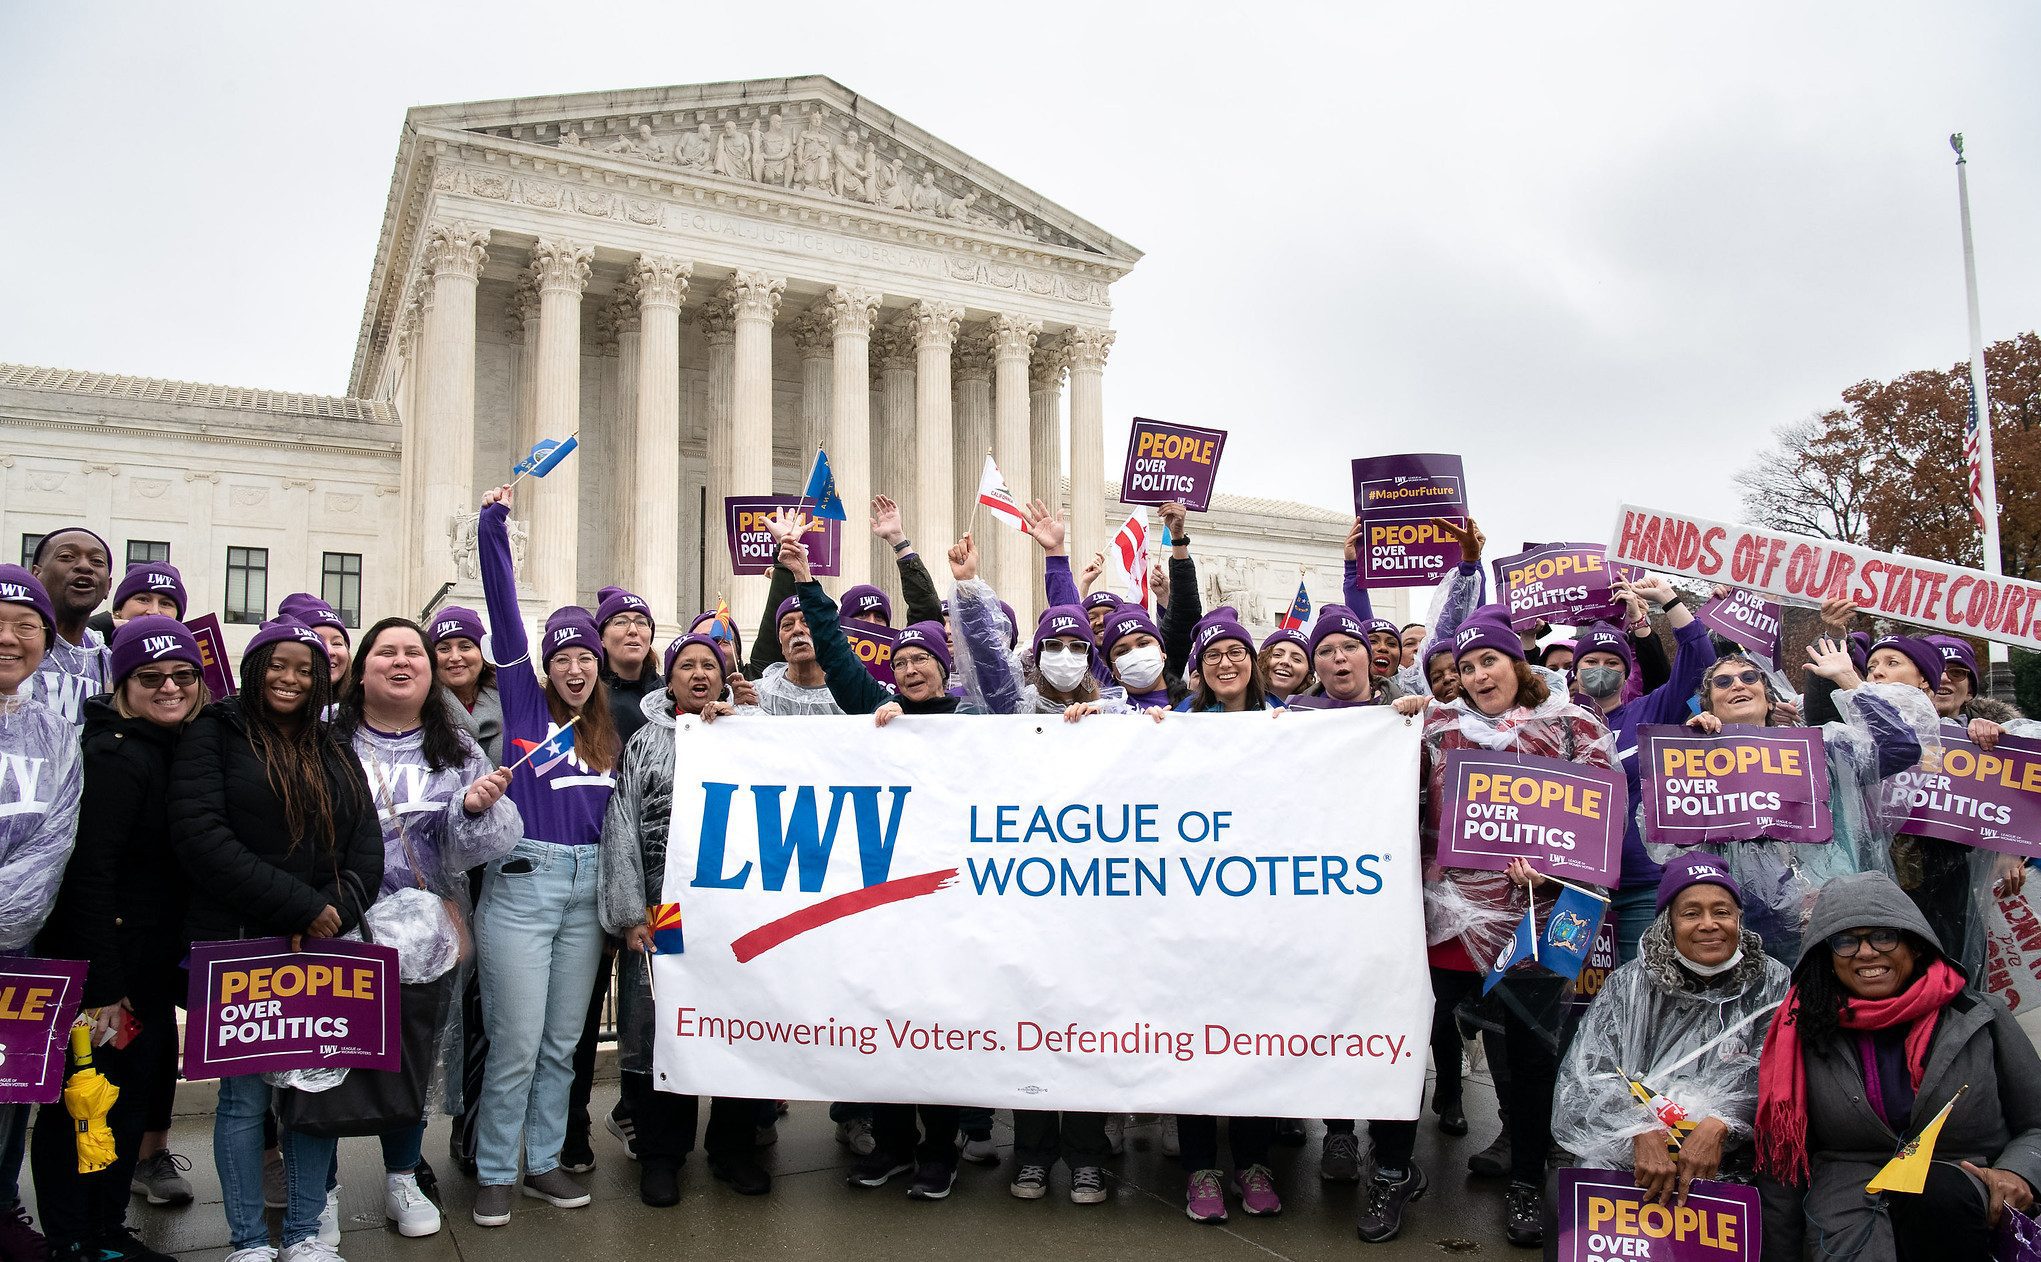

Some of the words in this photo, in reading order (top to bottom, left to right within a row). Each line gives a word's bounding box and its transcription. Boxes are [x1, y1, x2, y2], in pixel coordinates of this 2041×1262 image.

[681, 212, 746, 238] EQUAL
[751, 223, 824, 250] JUSTICE
[832, 238, 890, 264] UNDER
[898, 254, 932, 271] LAW
[1137, 432, 1214, 465] PEOPLE
[1135, 458, 1167, 473] OVER
[1131, 473, 1195, 493] POLITICS
[1368, 486, 1454, 500] #MapOurFuture
[740, 532, 772, 543] OVER
[1371, 545, 1406, 556] OVER
[1371, 555, 1444, 571] POLITICS
[1509, 554, 1603, 590] PEOPLE
[1617, 510, 1727, 576] HANDS
[1730, 533, 1788, 589] OFF
[1785, 543, 1857, 600] OUR
[1852, 559, 1948, 620] STATE
[147, 573, 174, 587] LWV
[1093, 593, 1112, 601] LWV
[1510, 581, 1545, 600] OVER
[623, 596, 645, 607] LWV
[860, 596, 880, 607] LWV
[1510, 585, 1589, 615] POLITICS
[1735, 589, 1766, 611] OVER
[437, 621, 460, 633] LWV
[1052, 616, 1075, 628] LWV
[1117, 619, 1139, 633] LWV
[1341, 617, 1361, 633] LWV
[1371, 621, 1391, 630] LWV
[293, 627, 319, 641] LWV
[554, 628, 578, 642] LWV
[899, 629, 922, 640] LWV
[1200, 624, 1221, 643] LWV
[1287, 630, 1307, 642] LWV
[1456, 627, 1479, 646] LWV
[1593, 631, 1615, 642] LWV
[143, 635, 176, 653] LWV
[671, 635, 693, 652] LWV
[1662, 746, 1803, 777] PEOPLE
[1921, 745, 2041, 793] EOPLE
[1665, 778, 1720, 794] OVER
[1895, 772, 1951, 791] OVER
[1467, 772, 1602, 820] PEOPLE
[1666, 791, 1781, 816] POLITICS
[1466, 803, 1520, 821] OVER
[1889, 787, 2012, 825] POLITICS
[969, 804, 1160, 844] LEAGUE
[1177, 810, 1233, 843] OF
[1756, 816, 1773, 826] LWV
[690, 781, 911, 893] LWV
[1463, 820, 1576, 850] POLITICS
[1980, 826, 1998, 837] LWV
[1549, 853, 1565, 864] LWV
[965, 857, 1167, 898] WOMEN
[1687, 865, 1717, 876] LWV
[221, 964, 375, 1004] PEOPLE
[220, 1000, 283, 1023] OVER
[218, 1016, 349, 1047] POLITICS
[676, 1006, 878, 1055] Empowering
[885, 1018, 1006, 1052] Voters.
[1016, 1021, 1195, 1062] Defending
[1204, 1023, 1412, 1065] Democracy.
[320, 1045, 338, 1055] LWV
[1588, 1196, 1739, 1252] PEOPLE
[1587, 1234, 1651, 1258] OVER
